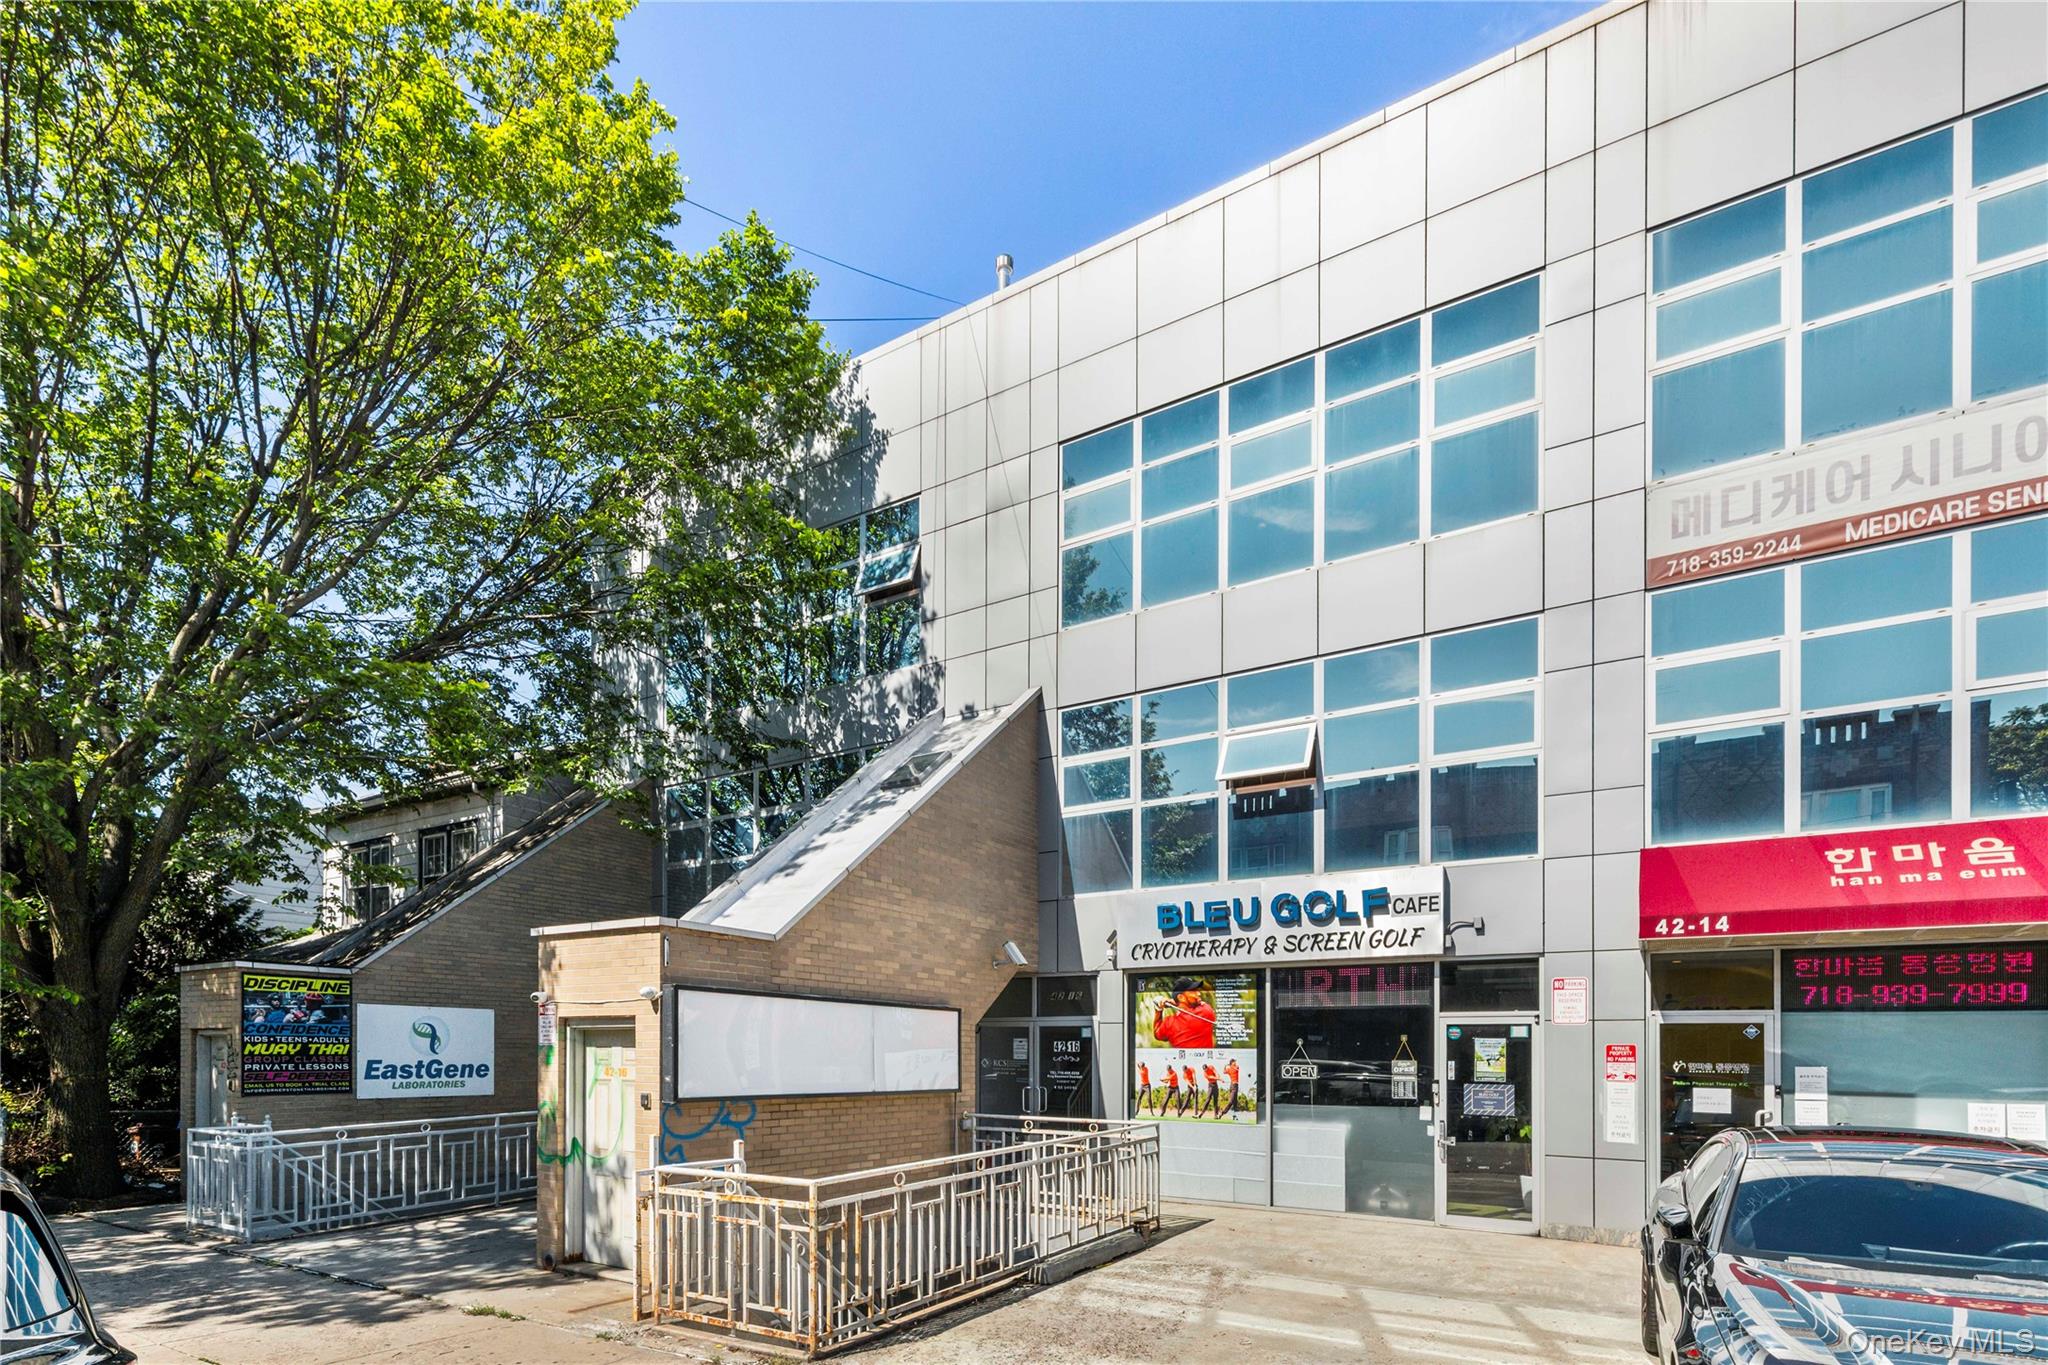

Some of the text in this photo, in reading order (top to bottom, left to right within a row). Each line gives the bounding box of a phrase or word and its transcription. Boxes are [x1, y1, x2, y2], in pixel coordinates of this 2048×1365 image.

[1671, 455, 1871, 540] 메디케어
[1667, 534, 1802, 577] 718-359-2244
[1846, 494, 1981, 543] MEDICARE
[1830, 866, 2027, 887] han ma eum
[1156, 886, 1440, 932] BLEU GOLF CAFE
[1655, 915, 1729, 935] 42-14
[1131, 927, 1426, 961] CRYOTHERAPY & SCREEN GOLF
[245, 977, 350, 993] DISCIPLINE
[1800, 982, 2028, 1005] 718-939-7999
[245, 1024, 350, 1035] CONFIDENCE
[244, 1043, 350, 1055] MUAY THAI
[244, 1072, 349, 1081] SELF-DEFENSE
[364, 1059, 490, 1080] EastGene
[1283, 1067, 1315, 1077] OPEN
[391, 1079, 466, 1090] LABORATORIES
